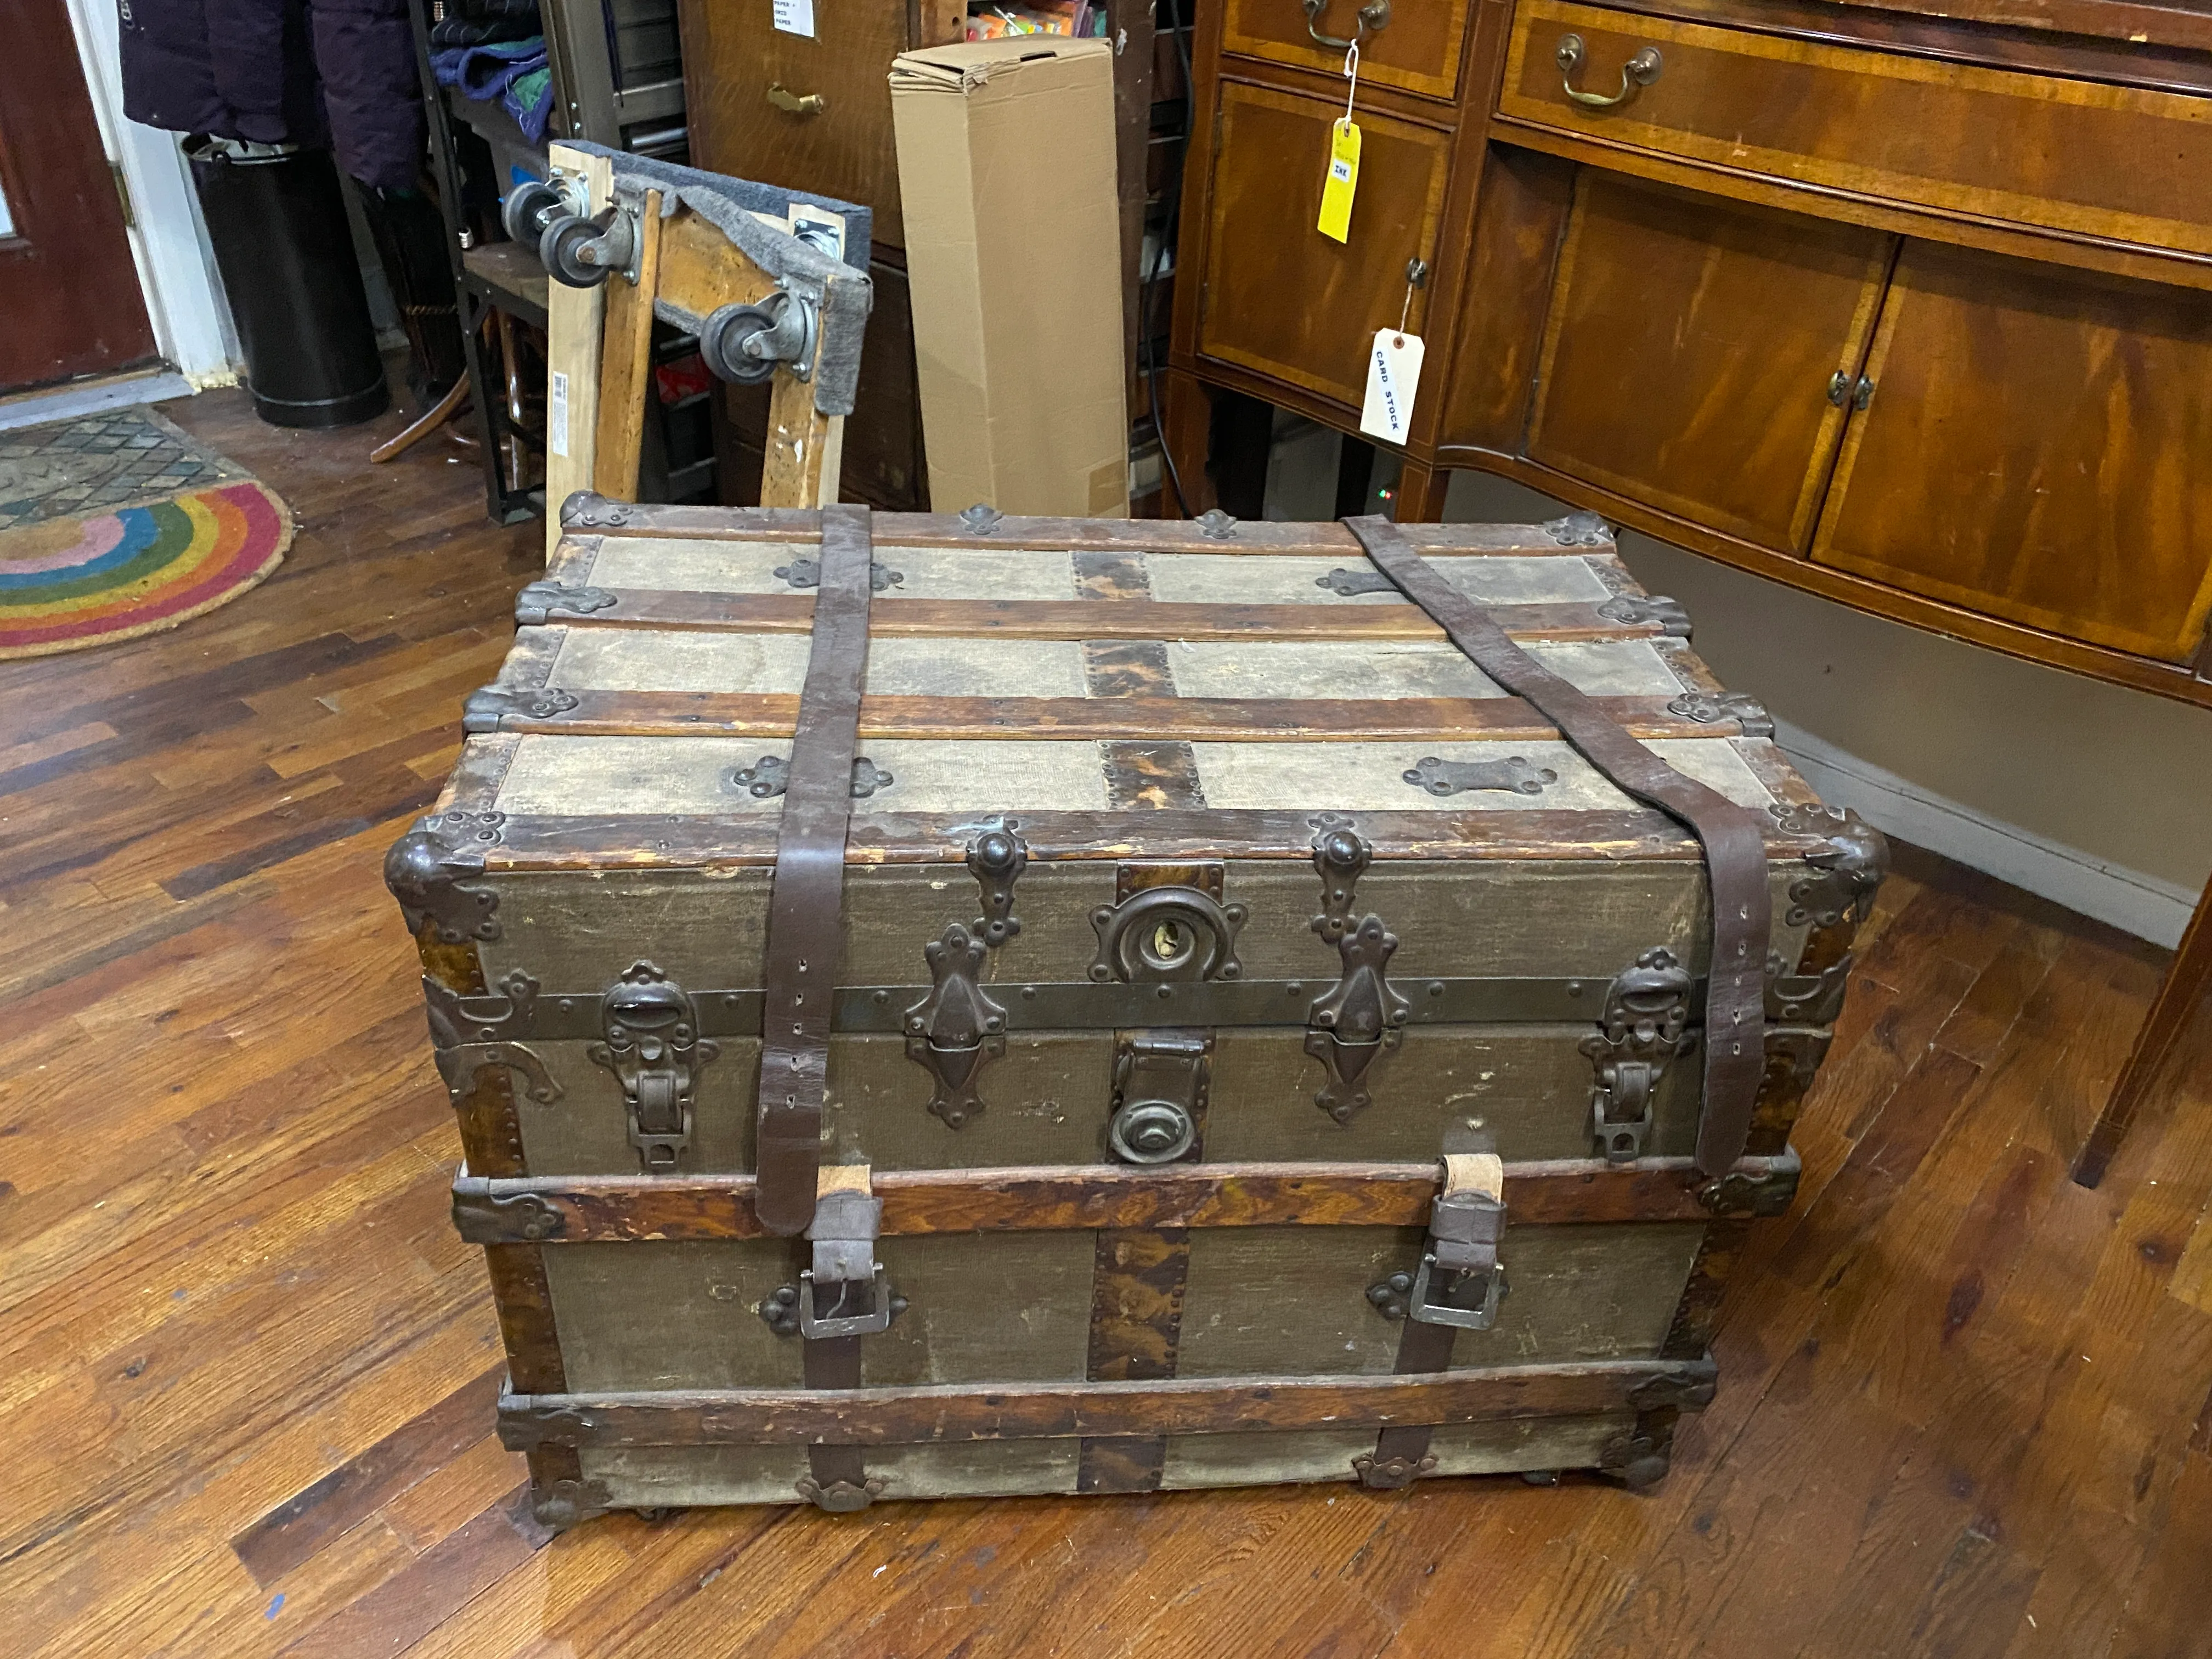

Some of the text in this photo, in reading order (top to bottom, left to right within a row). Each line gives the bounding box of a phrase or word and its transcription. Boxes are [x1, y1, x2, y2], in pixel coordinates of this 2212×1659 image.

[1335, 165, 1347, 177] INK
[1376, 351, 1399, 431] CARD STOCK
